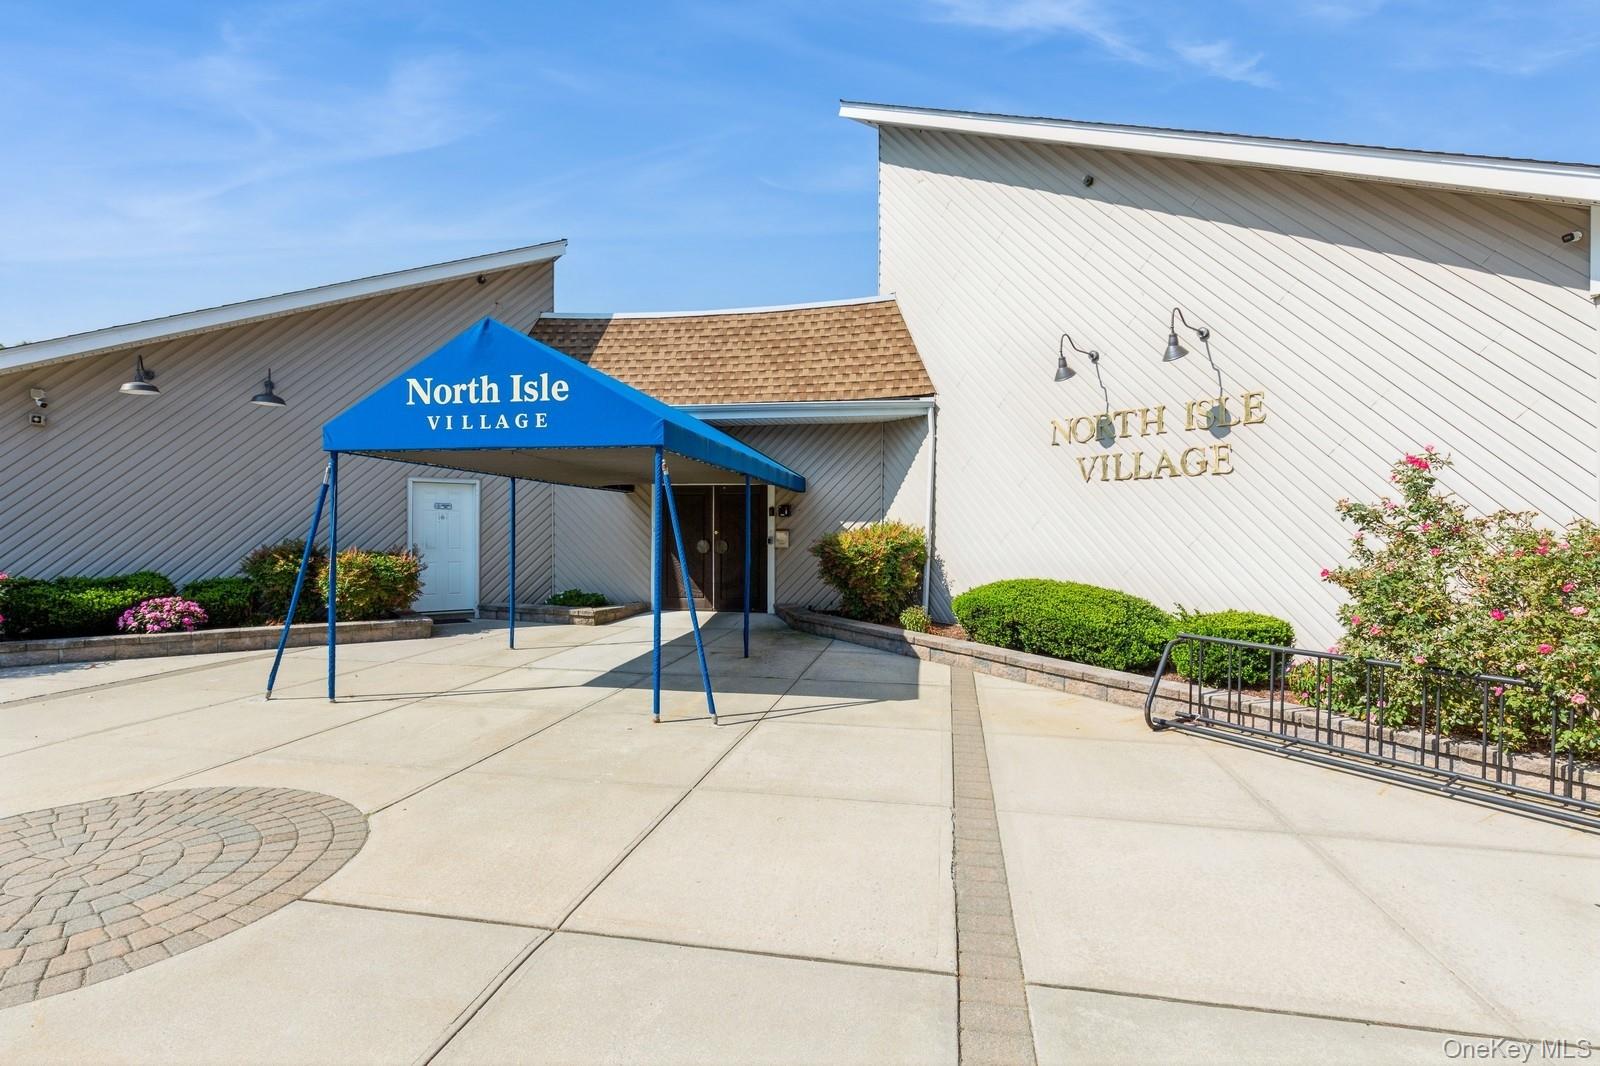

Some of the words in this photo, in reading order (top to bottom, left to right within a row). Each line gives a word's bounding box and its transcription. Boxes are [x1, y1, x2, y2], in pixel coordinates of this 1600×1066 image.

[407, 375, 500, 405] North
[510, 372, 569, 403] Isle
[427, 413, 548, 430] VILLAGE
[1050, 404, 1167, 446] NORTH
[1184, 390, 1267, 431] ISLE
[1076, 443, 1234, 483] VILLAGE
